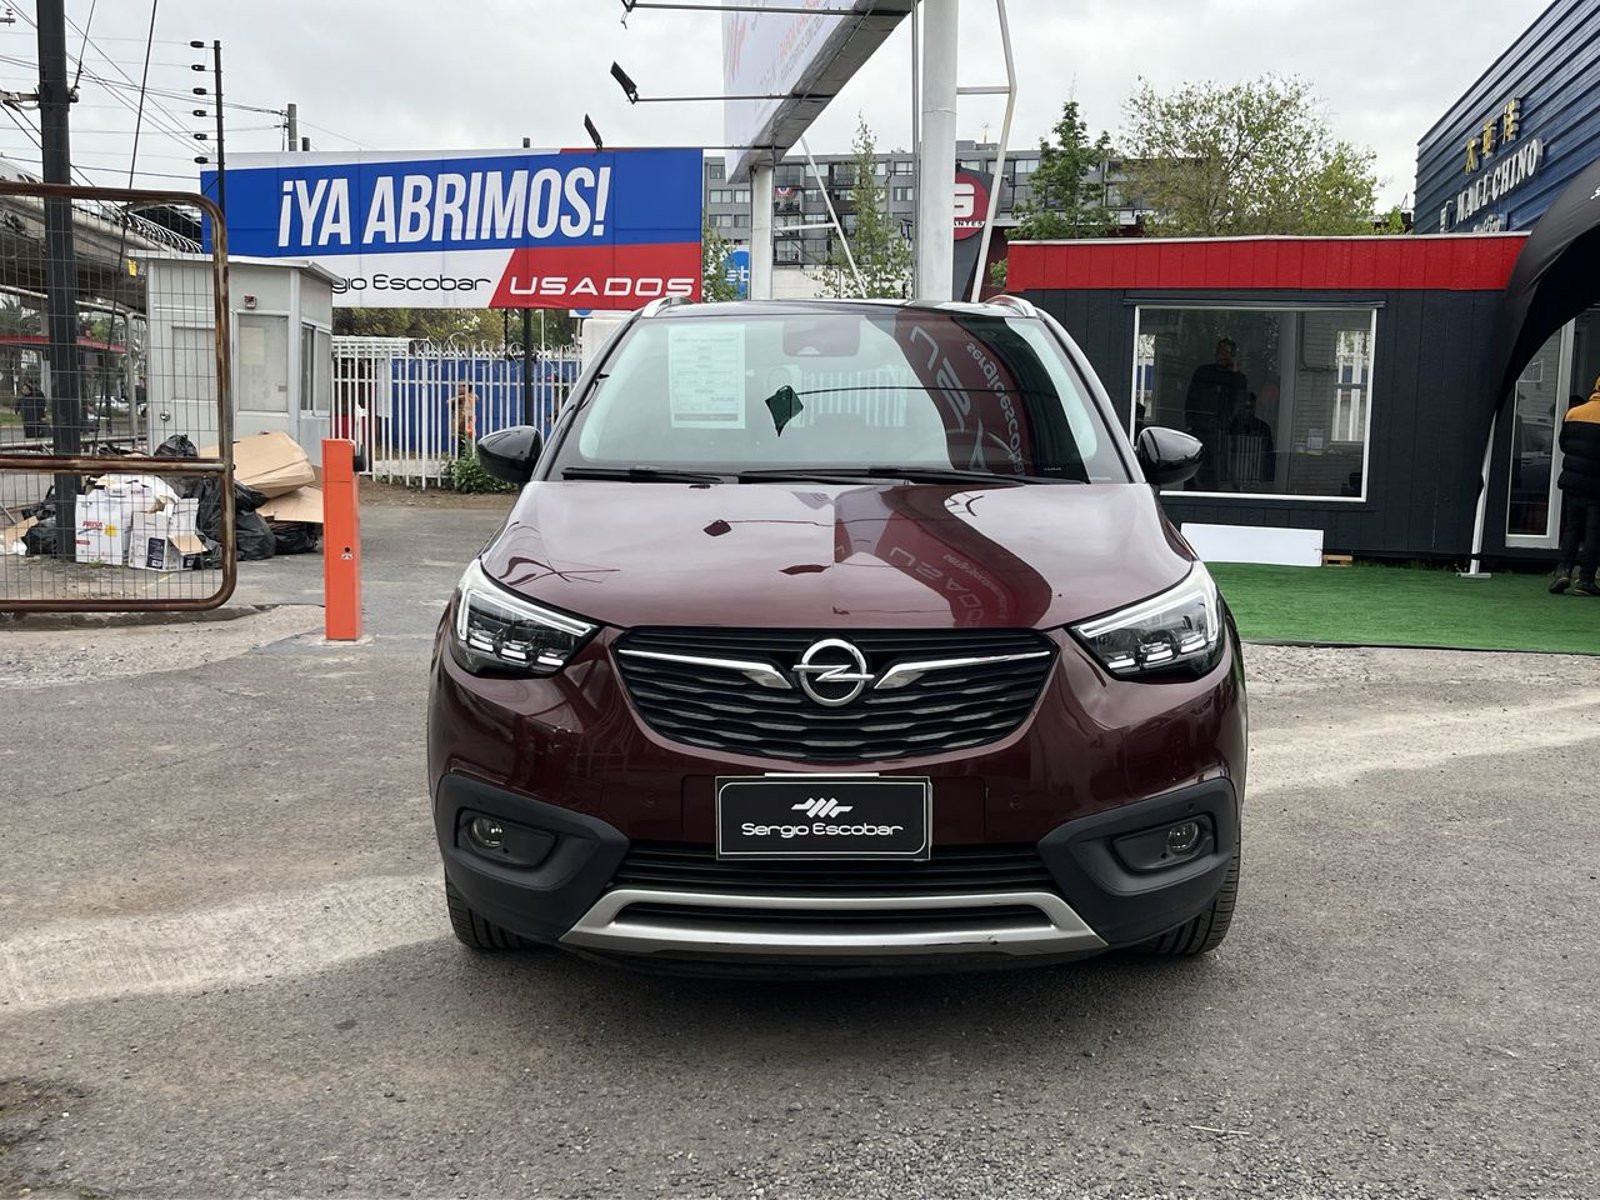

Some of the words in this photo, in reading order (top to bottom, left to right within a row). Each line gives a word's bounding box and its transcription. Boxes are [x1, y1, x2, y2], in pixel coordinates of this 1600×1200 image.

[1492, 139, 1542, 200] CHINO
[278, 178, 351, 247] ¡YA
[362, 167, 611, 244] ABRIMOS!
[373, 274, 492, 291] Escobar
[509, 276, 695, 296] USADOS
[741, 822, 809, 838] Sergio
[812, 822, 903, 836] Escobar
